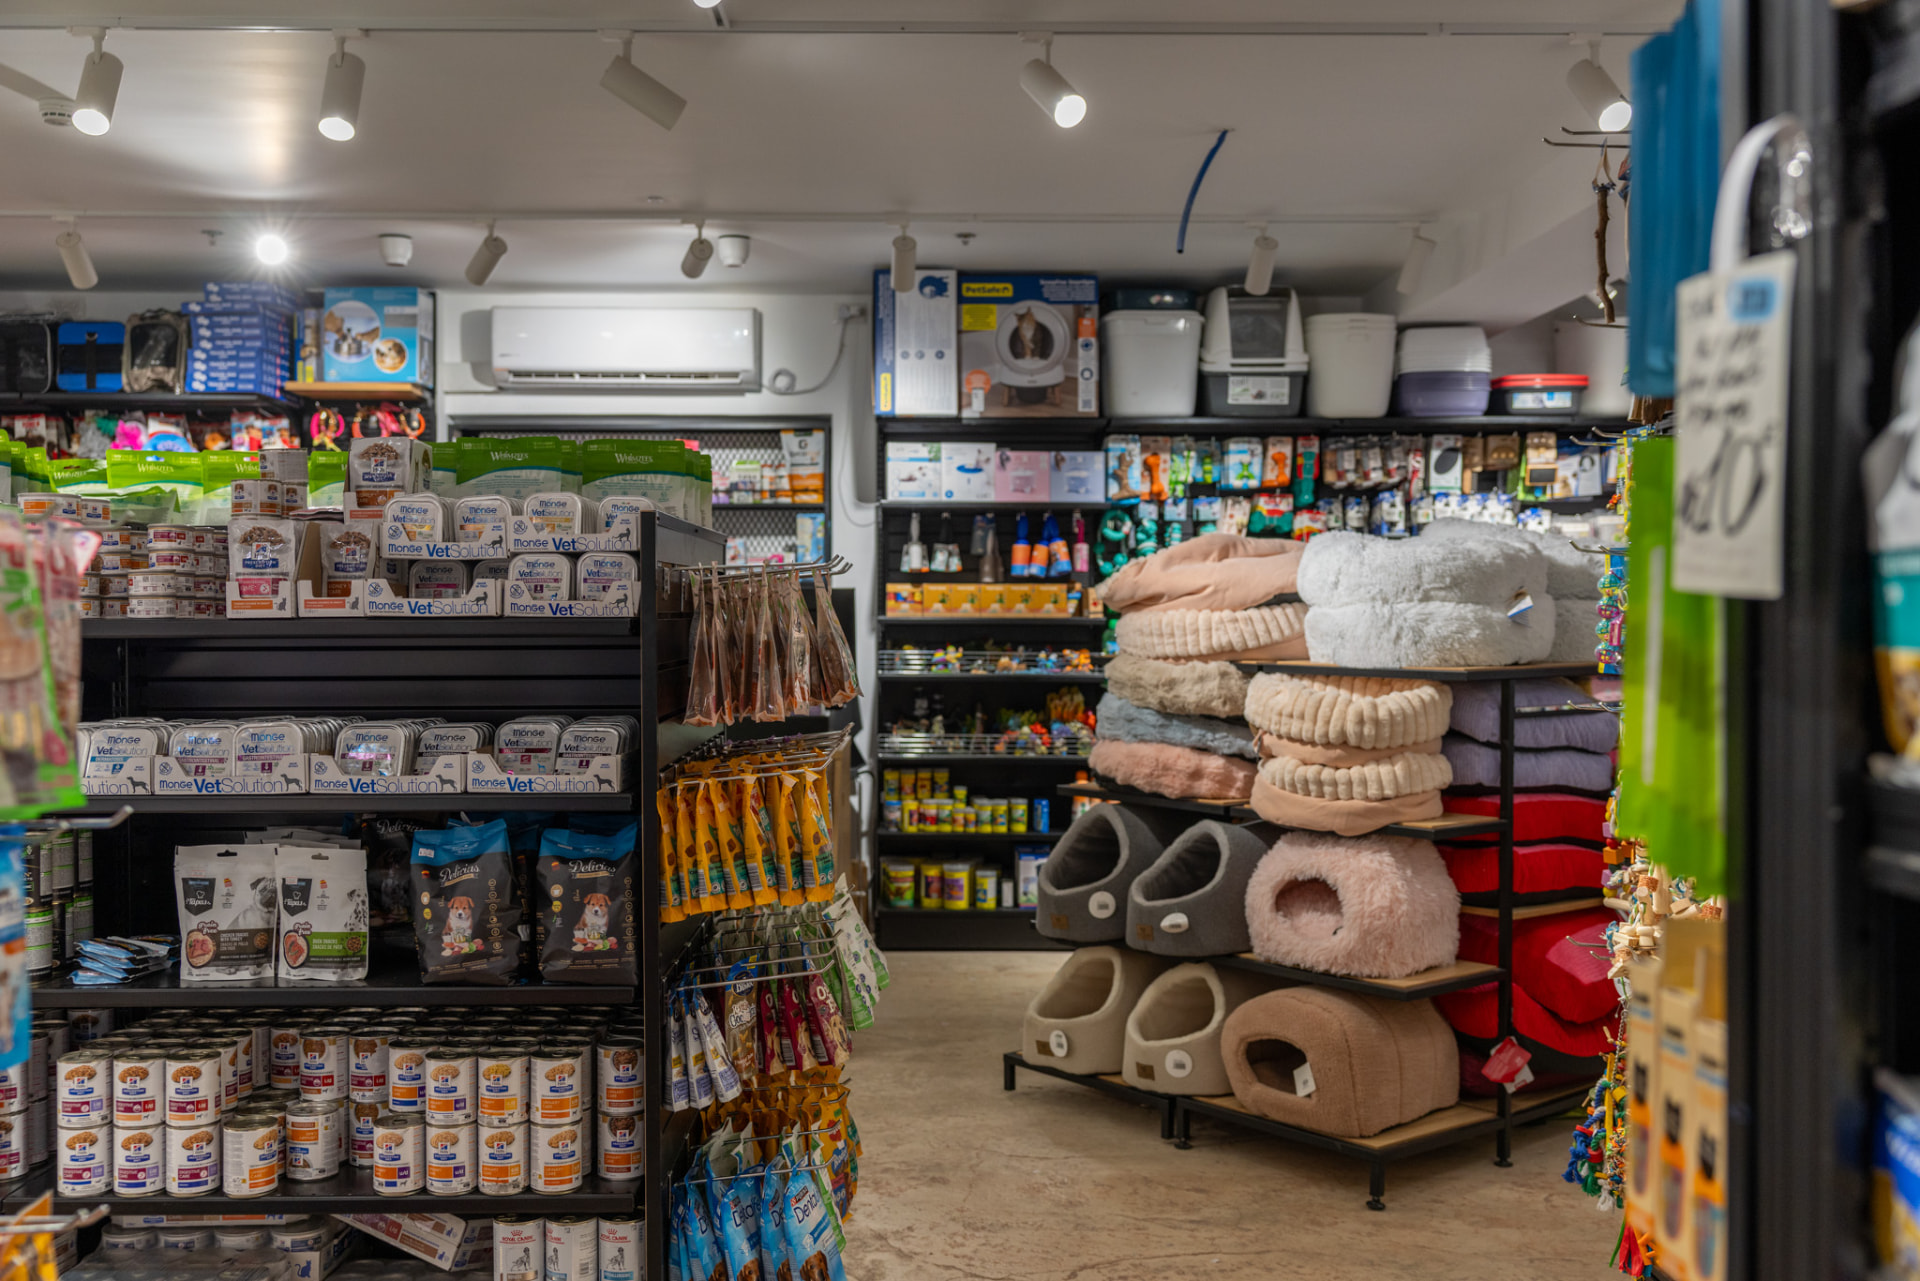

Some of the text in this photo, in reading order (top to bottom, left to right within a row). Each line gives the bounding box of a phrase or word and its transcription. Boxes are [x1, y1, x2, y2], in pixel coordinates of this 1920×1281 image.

[965, 285, 1001, 294] PetSafe
[491, 450, 529, 461] WHIMZEES
[615, 452, 653, 464] WHIMZEES
[539, 500, 567, 508] Monge
[611, 504, 640, 512] Monge
[400, 505, 429, 515] Monge
[469, 506, 498, 514] Monge
[513, 537, 632, 551] Monge VetSolution
[388, 543, 505, 558] Monge VetSolution
[526, 561, 555, 569] Monge
[594, 560, 623, 568] Monge
[368, 601, 488, 615] Monge VetSolution
[510, 602, 630, 616] Monge VetSolution
[251, 732, 285, 742] Monge
[355, 733, 388, 742] Monge
[513, 729, 545, 737] Monge
[107, 736, 141, 744] Monge
[188, 736, 222, 745] Monge
[434, 734, 466, 742] Monge
[574, 735, 606, 743] Monge
[96, 746, 148, 756] VetSolution
[241, 744, 295, 753] VetSolution
[159, 778, 283, 793] Monge VetSolution
[314, 778, 438, 793] Monge VetSolution
[471, 777, 595, 792] Monge VetSolution
[568, 860, 616, 873] Delicias
